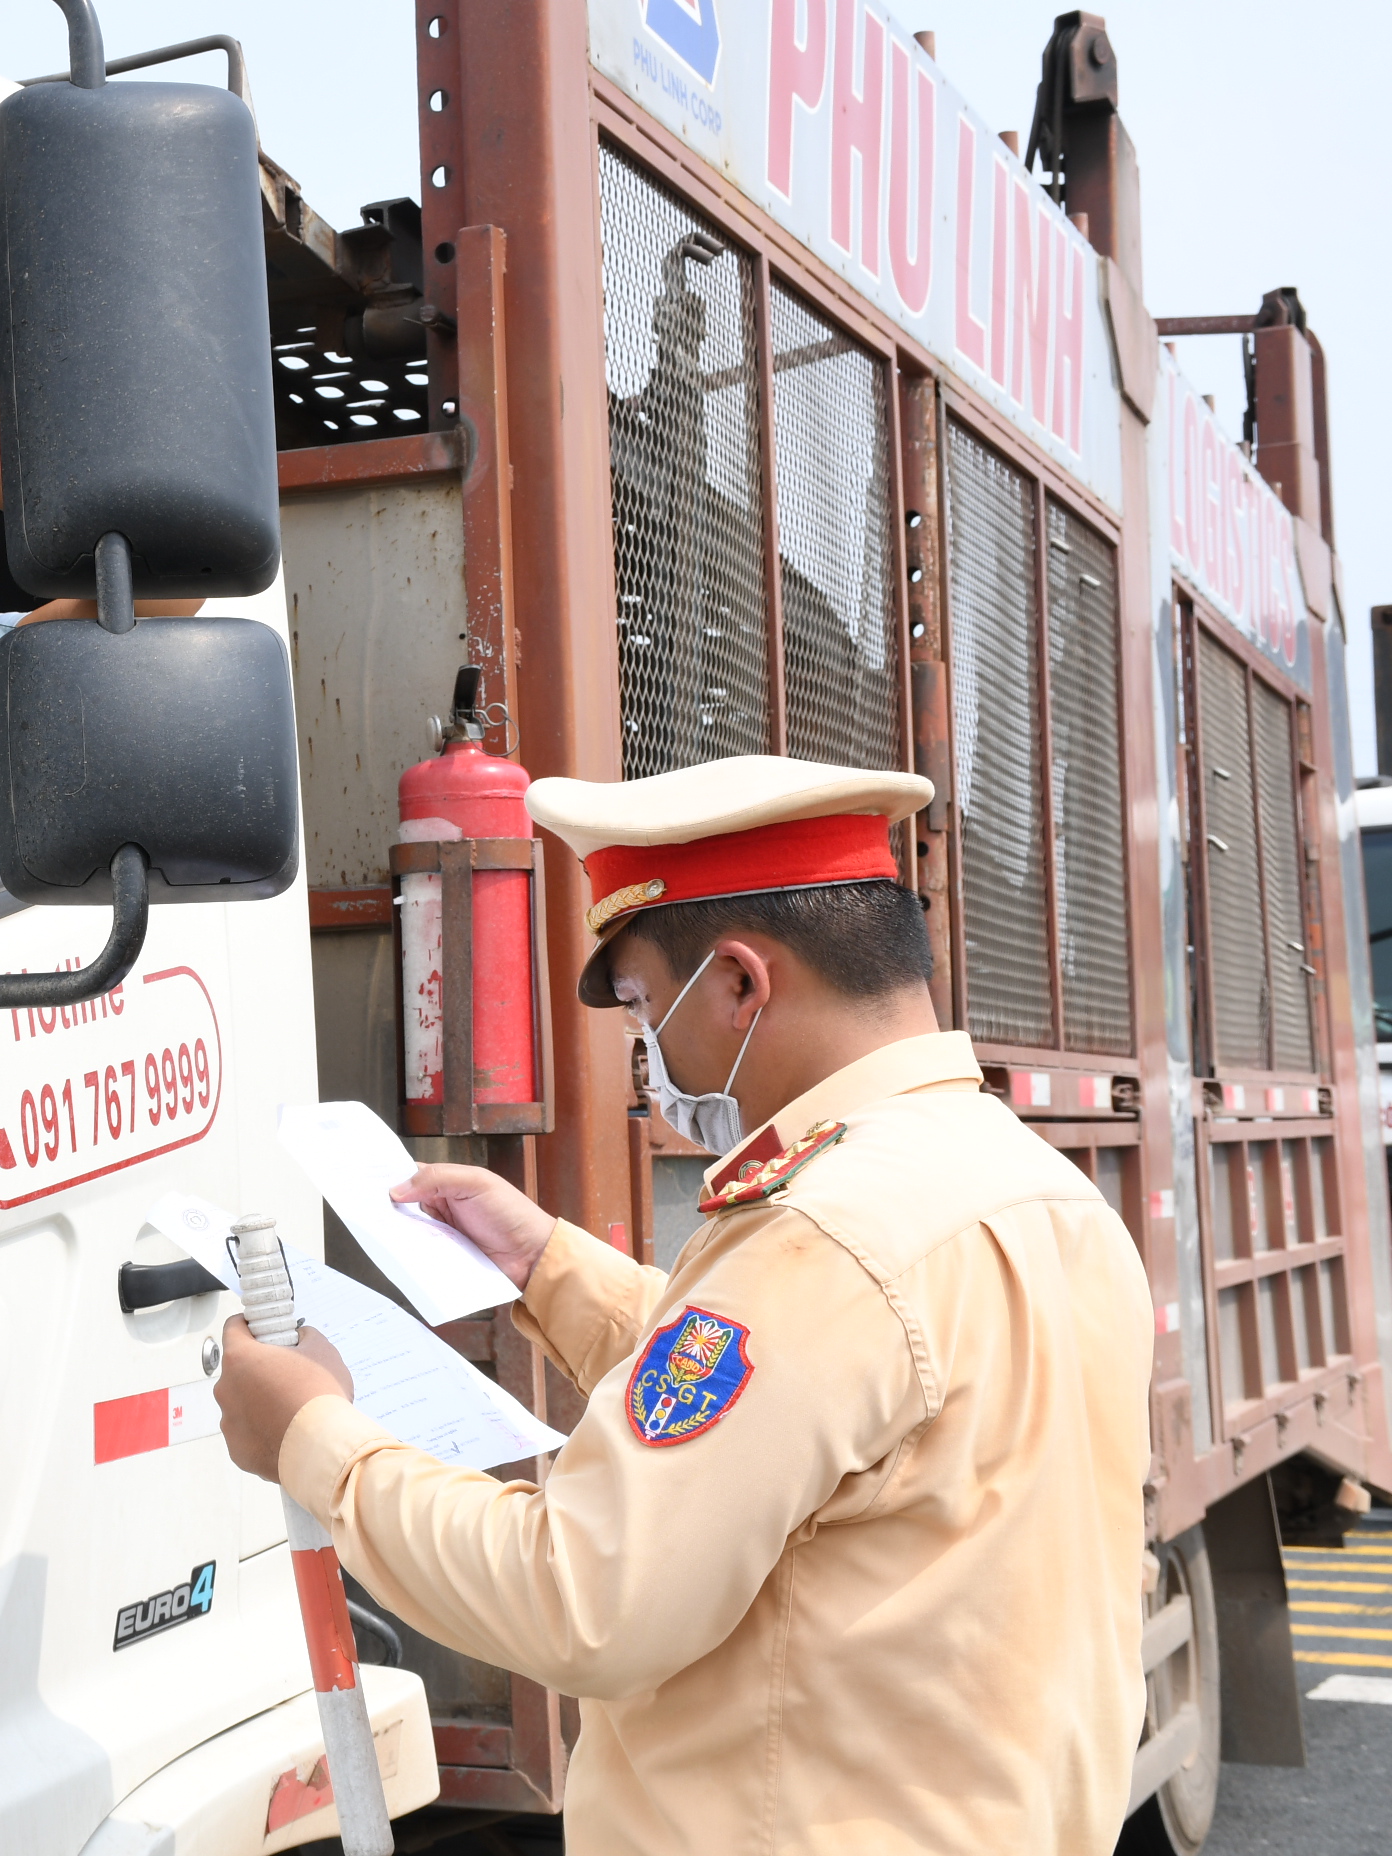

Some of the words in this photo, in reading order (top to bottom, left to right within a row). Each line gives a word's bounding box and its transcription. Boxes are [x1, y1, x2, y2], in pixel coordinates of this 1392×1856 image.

[633, 36, 658, 84] PHU
[660, 62, 688, 111] LINH
[691, 91, 722, 138] CORP
[953, 110, 1086, 461] LINH
[20, 1078, 78, 1168] 091
[83, 1059, 136, 1146] 767
[144, 1037, 211, 1127] 9999
[641, 1369, 718, 1412] CSGT
[675, 1355, 701, 1373] CAND
[172, 1405, 183, 1420] 3M
